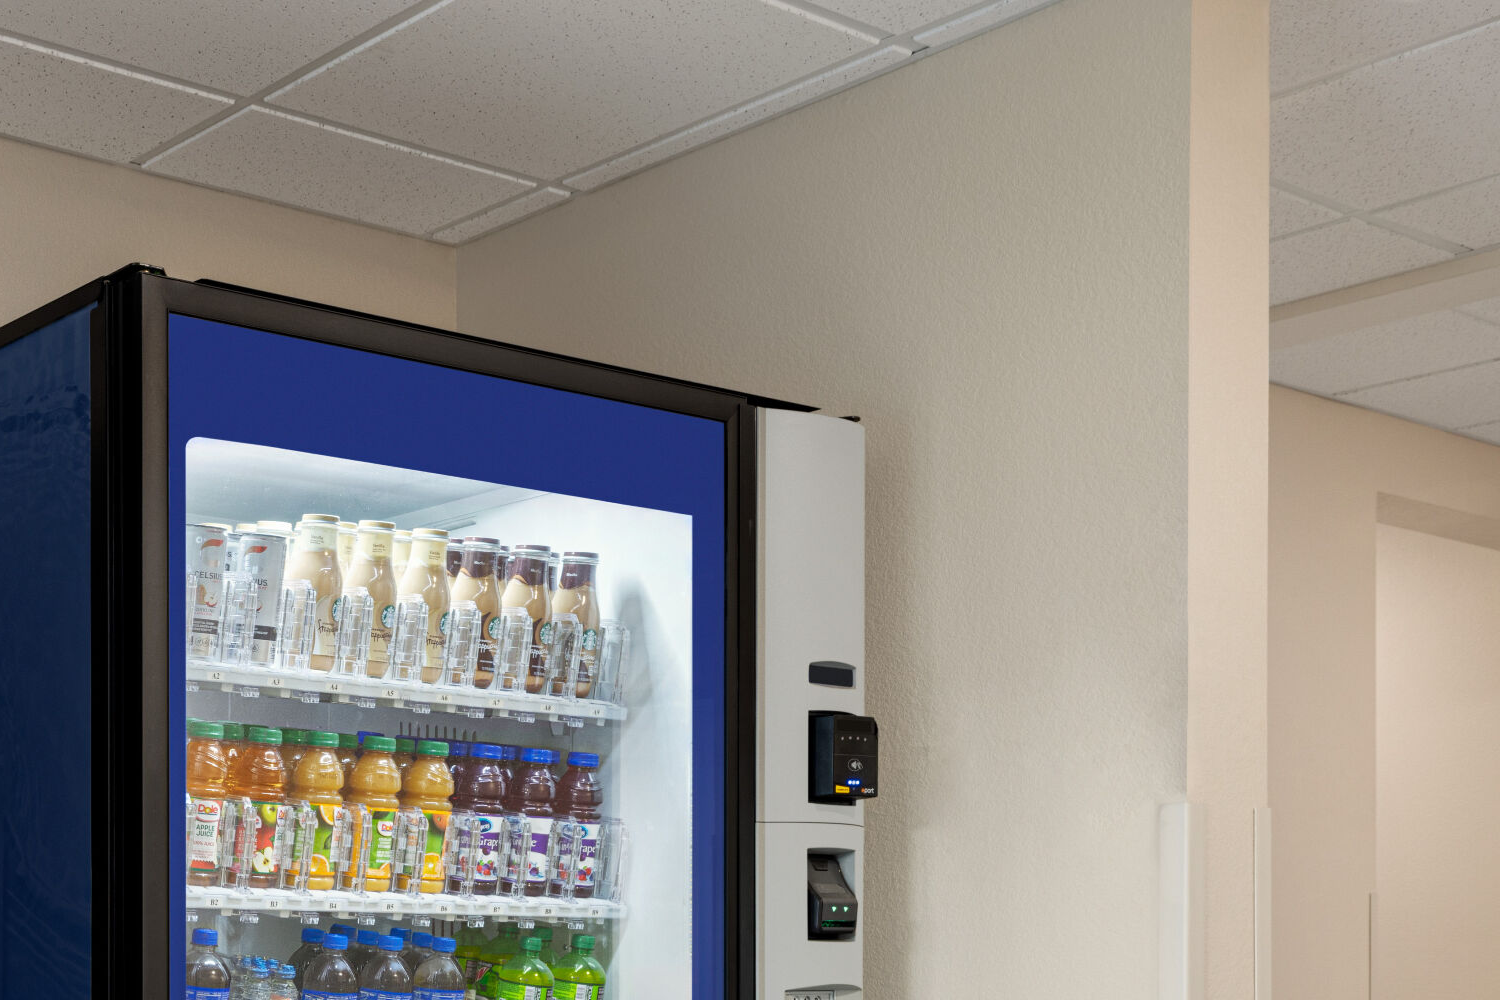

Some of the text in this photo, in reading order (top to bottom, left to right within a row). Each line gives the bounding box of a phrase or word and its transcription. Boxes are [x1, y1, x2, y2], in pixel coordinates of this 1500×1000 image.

[212, 672, 220, 680] A2
[198, 803, 218, 813] Dole
[196, 824, 215, 832] APPLE
[479, 836, 499, 850] Grap
